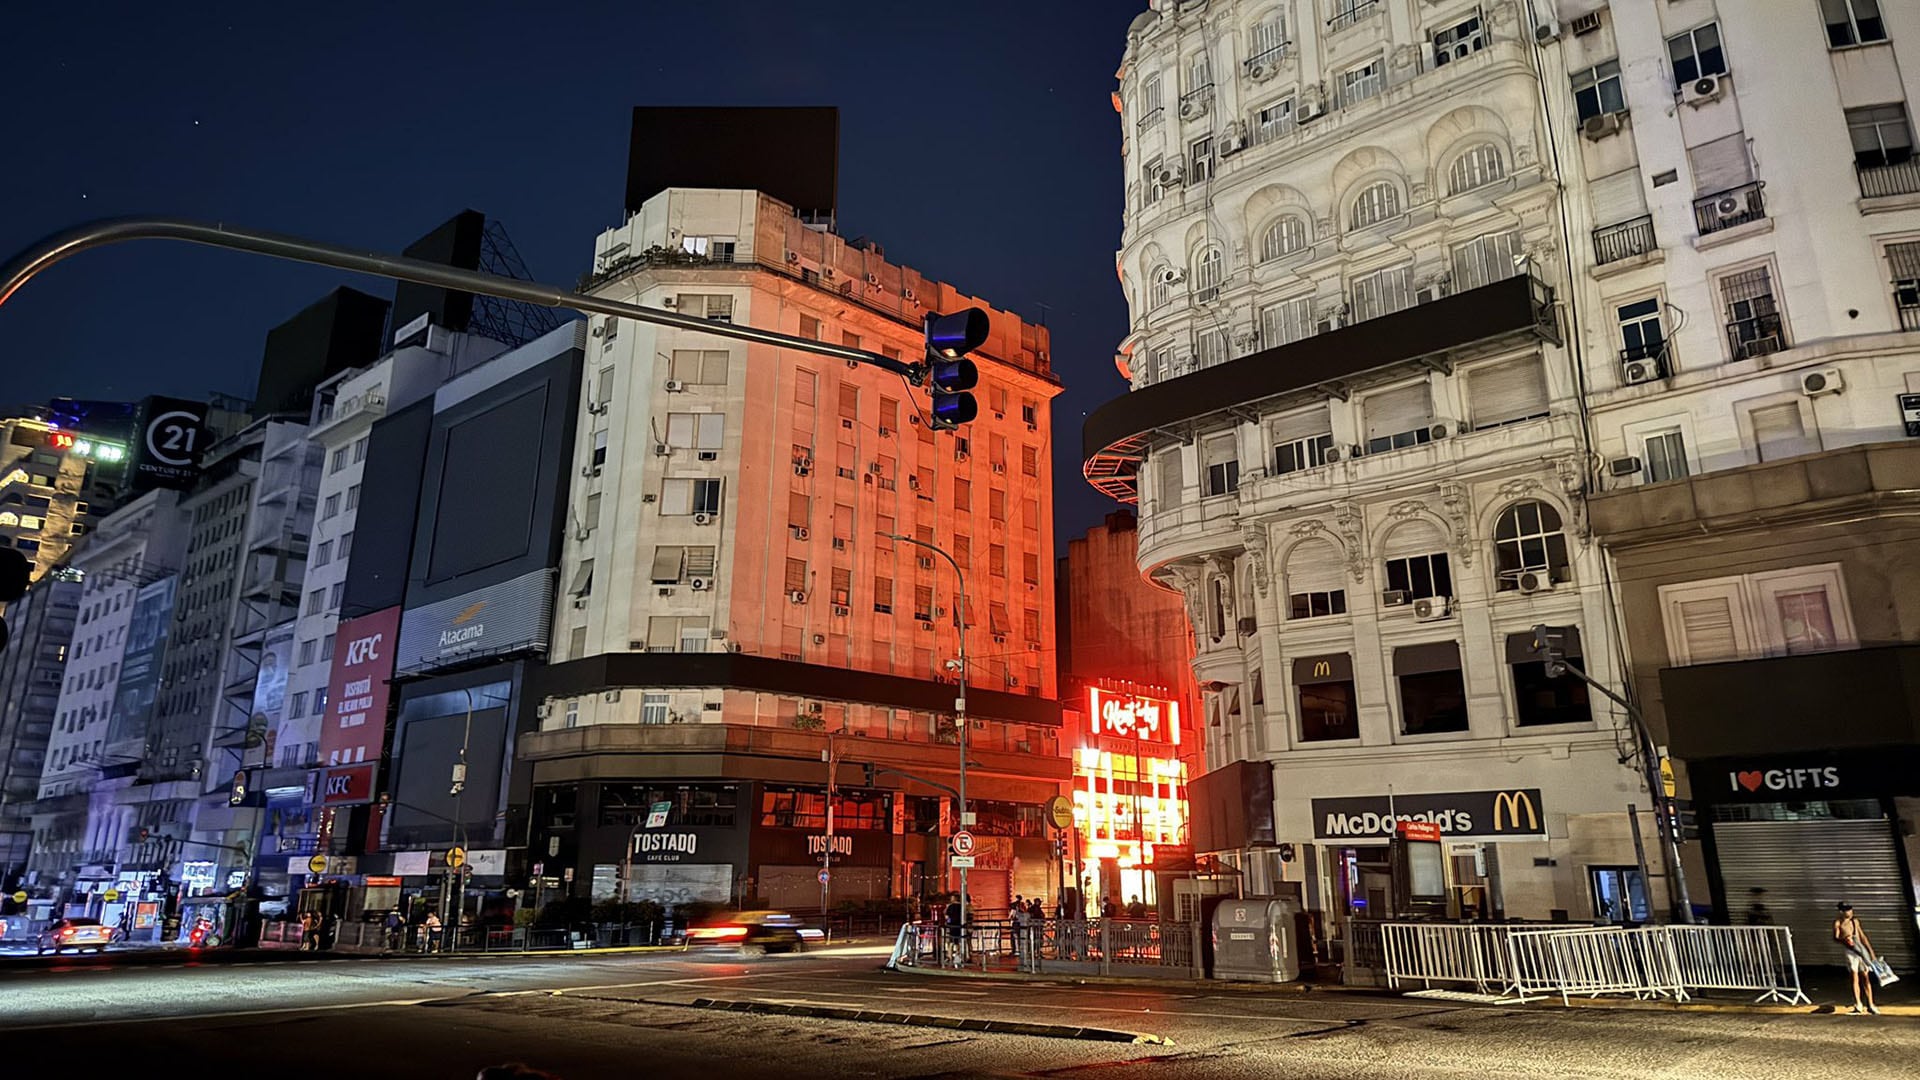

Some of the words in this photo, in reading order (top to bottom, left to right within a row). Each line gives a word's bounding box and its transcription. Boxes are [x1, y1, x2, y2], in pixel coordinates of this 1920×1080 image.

[438, 624, 484, 647] Atacama
[344, 633, 383, 667] KFC
[325, 775, 352, 795] KFC
[1764, 766, 1840, 790] GiFTS
[634, 833, 697, 855] TOSTADO
